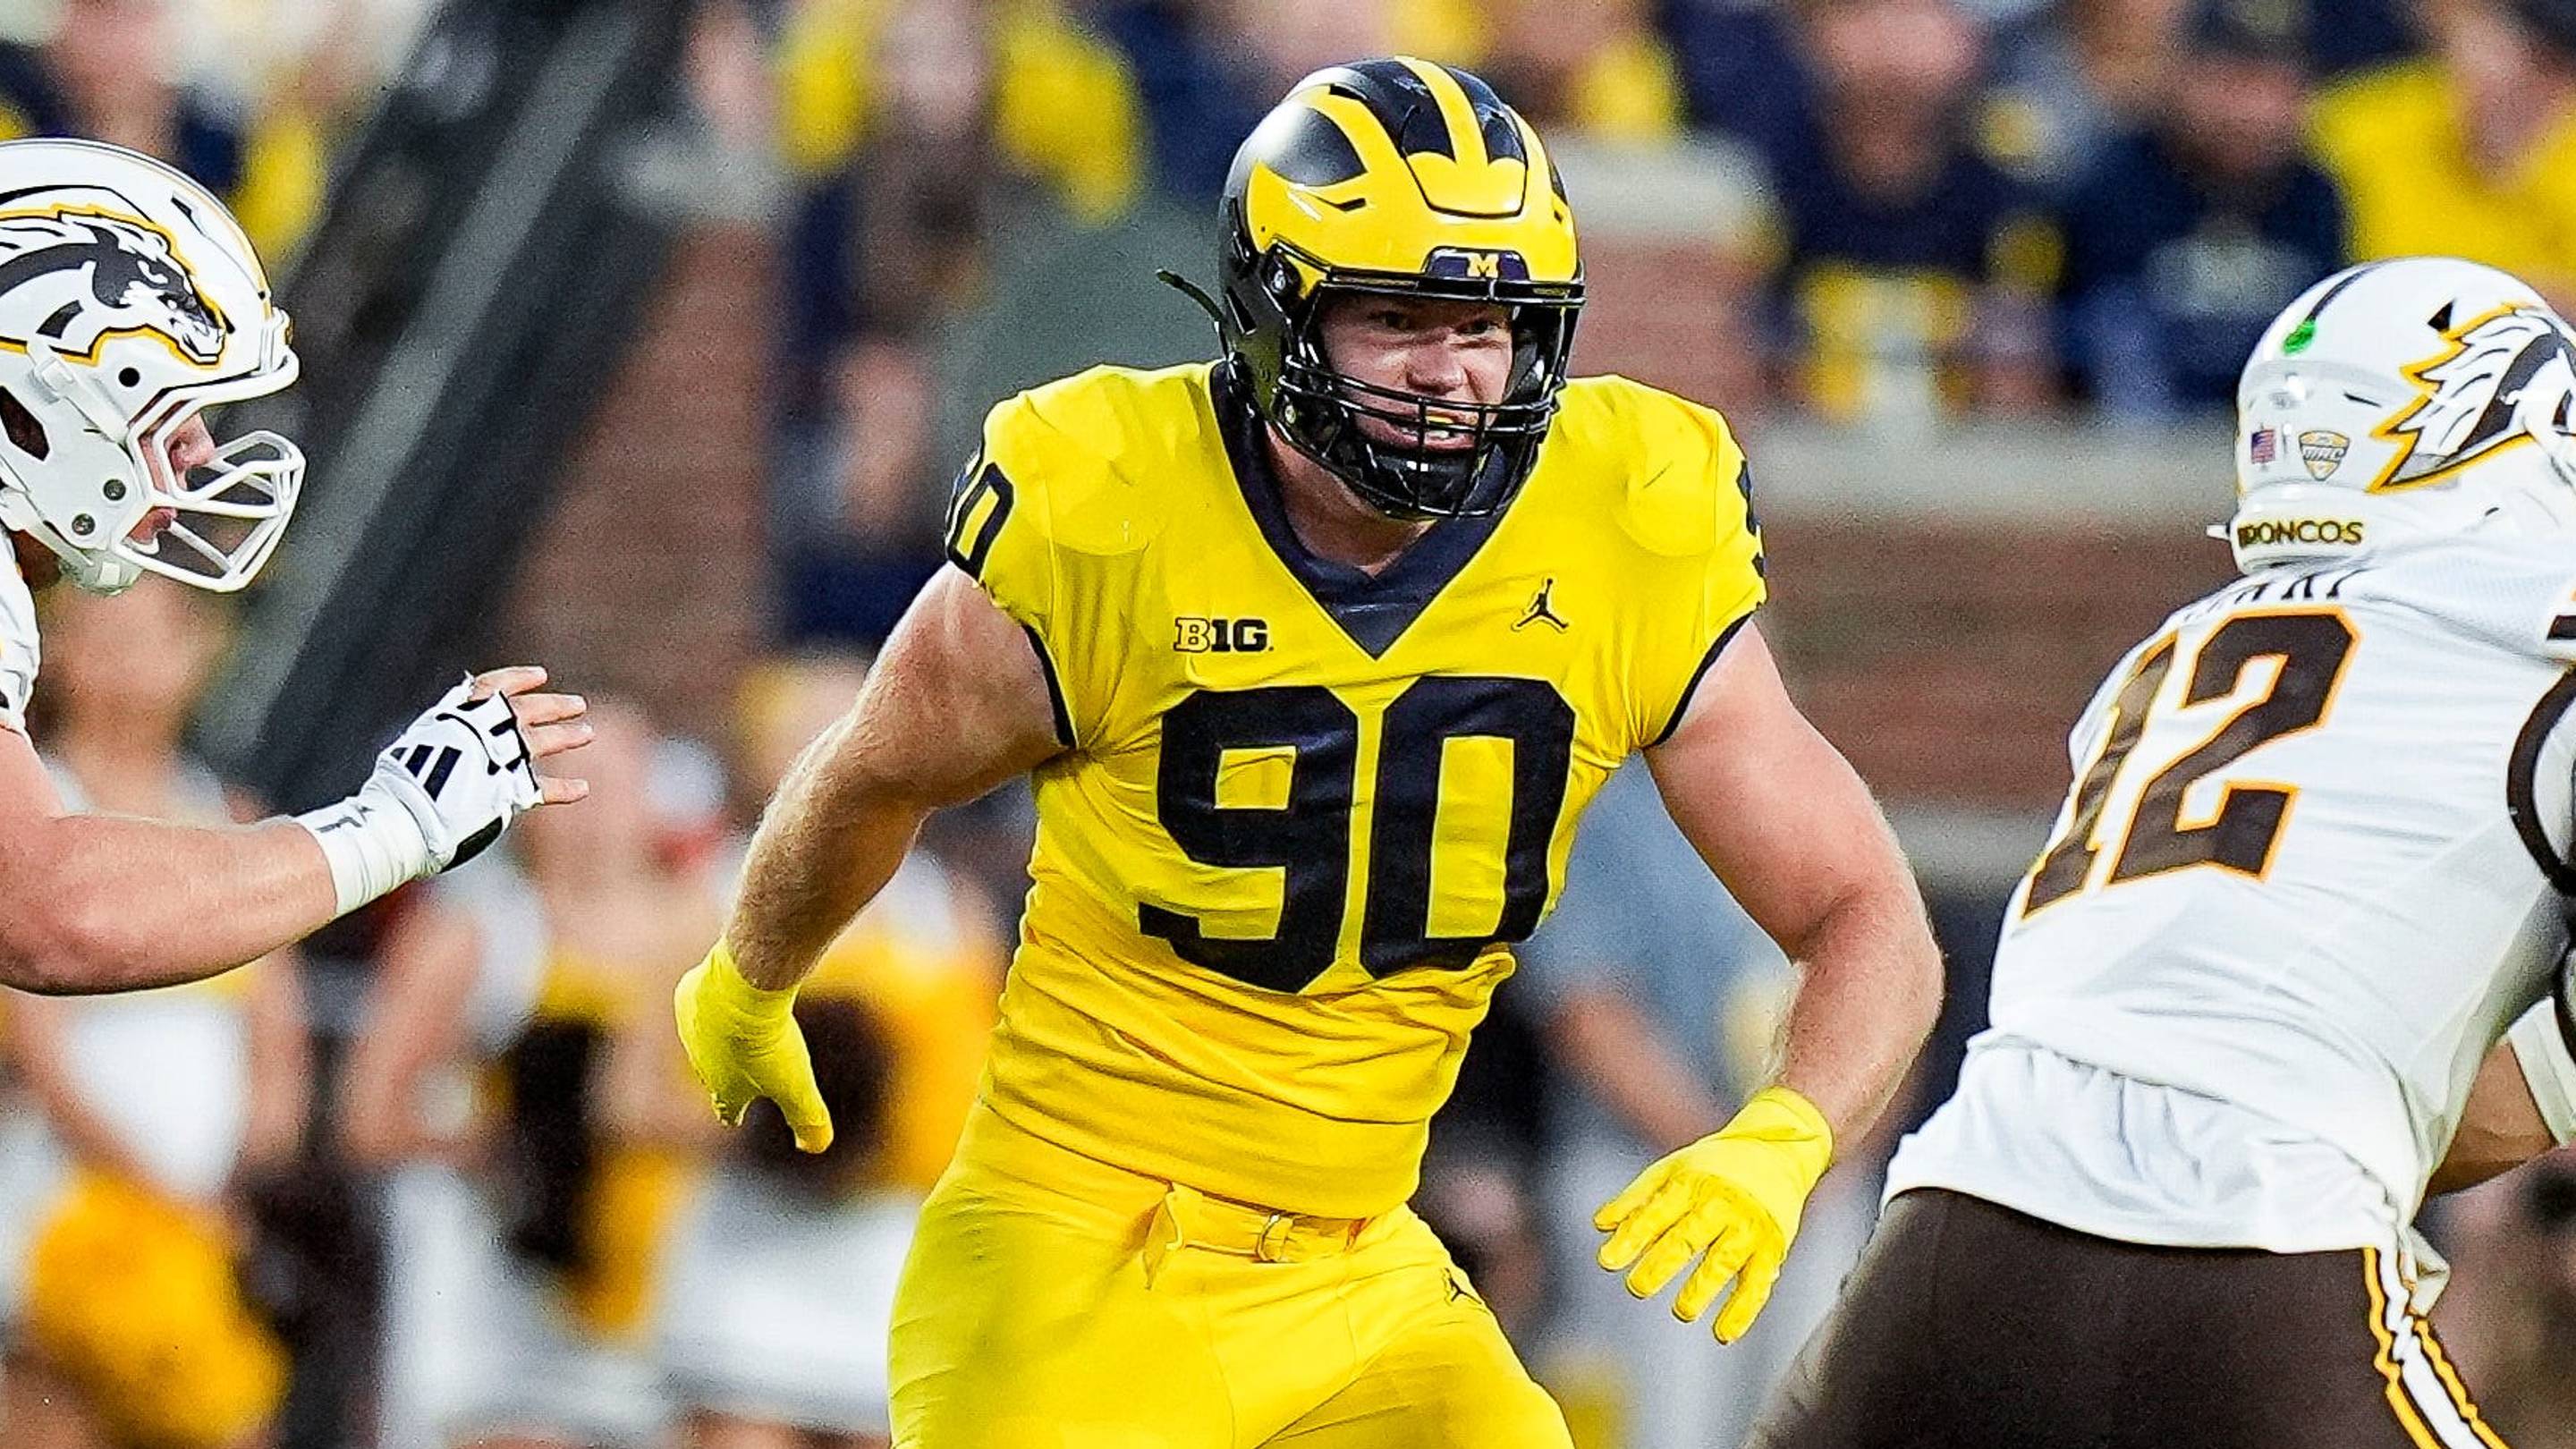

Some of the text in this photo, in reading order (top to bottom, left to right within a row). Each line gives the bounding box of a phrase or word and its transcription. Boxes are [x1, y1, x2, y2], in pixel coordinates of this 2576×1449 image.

[1467, 252, 1500, 278] M
[1138, 674, 1577, 995] 90
[2022, 605, 2363, 919] 12
